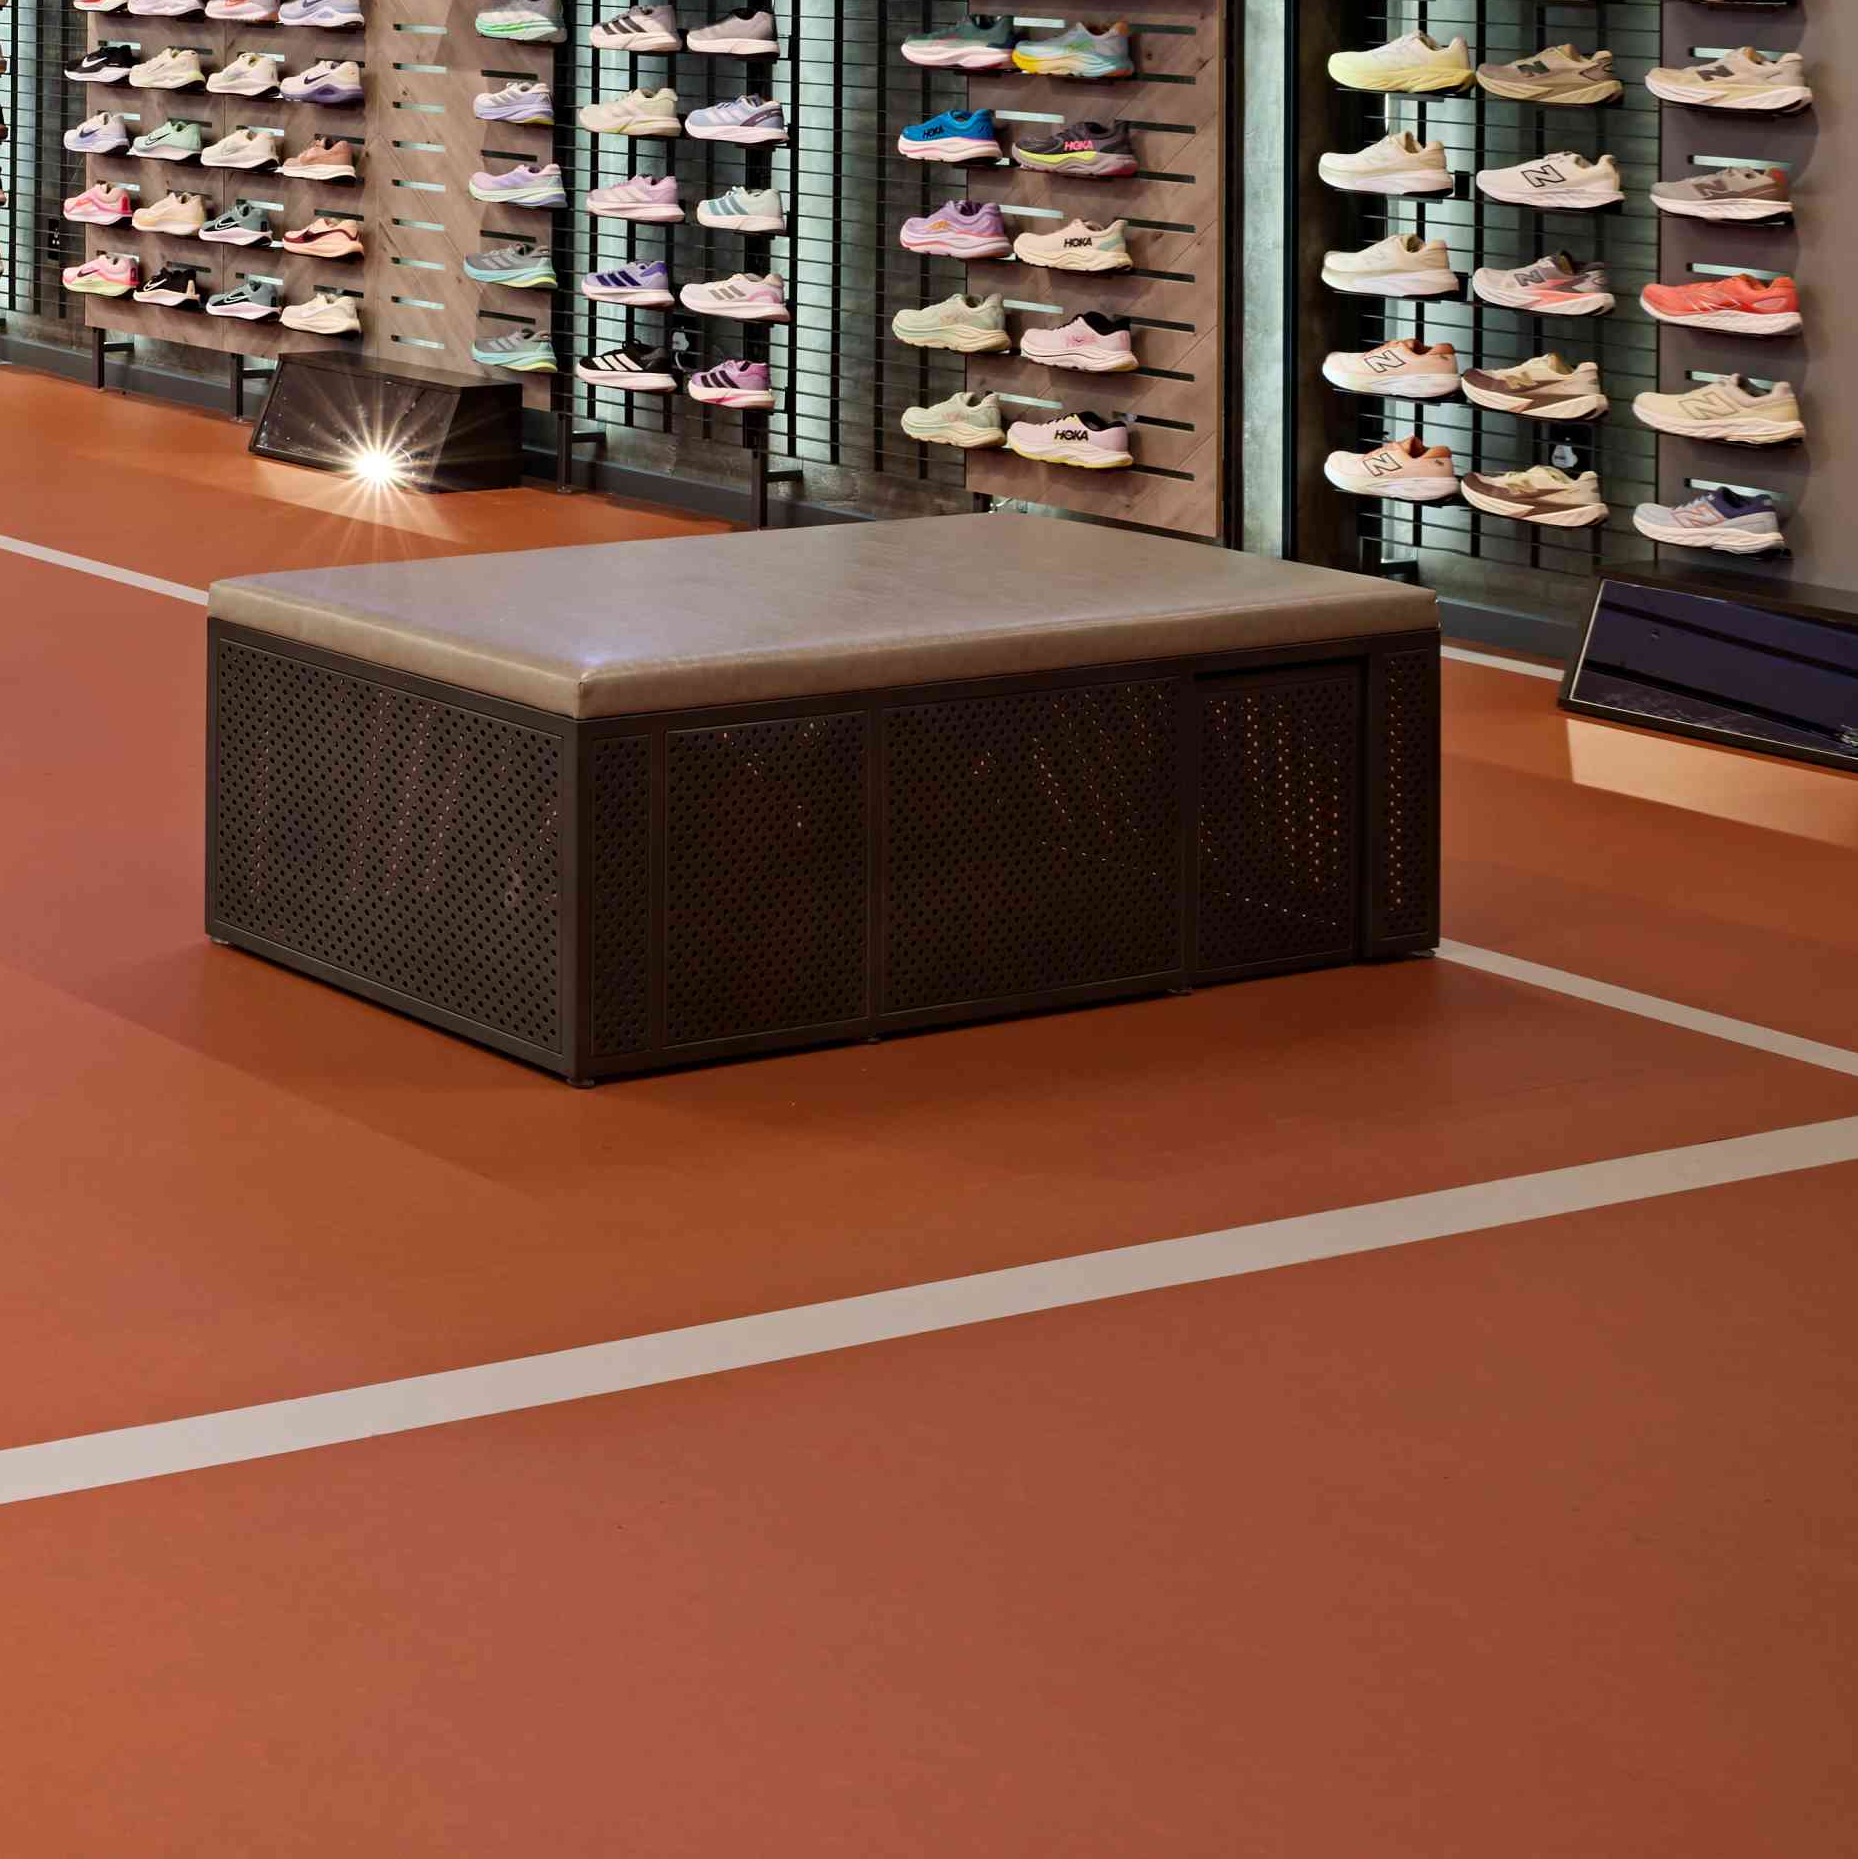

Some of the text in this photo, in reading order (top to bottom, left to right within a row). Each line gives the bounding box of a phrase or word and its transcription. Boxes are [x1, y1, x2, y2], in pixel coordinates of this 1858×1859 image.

[1064, 140, 1094, 151] HOKA
[1064, 237, 1092, 248] HOKA
[1054, 429, 1089, 441] HOKA
